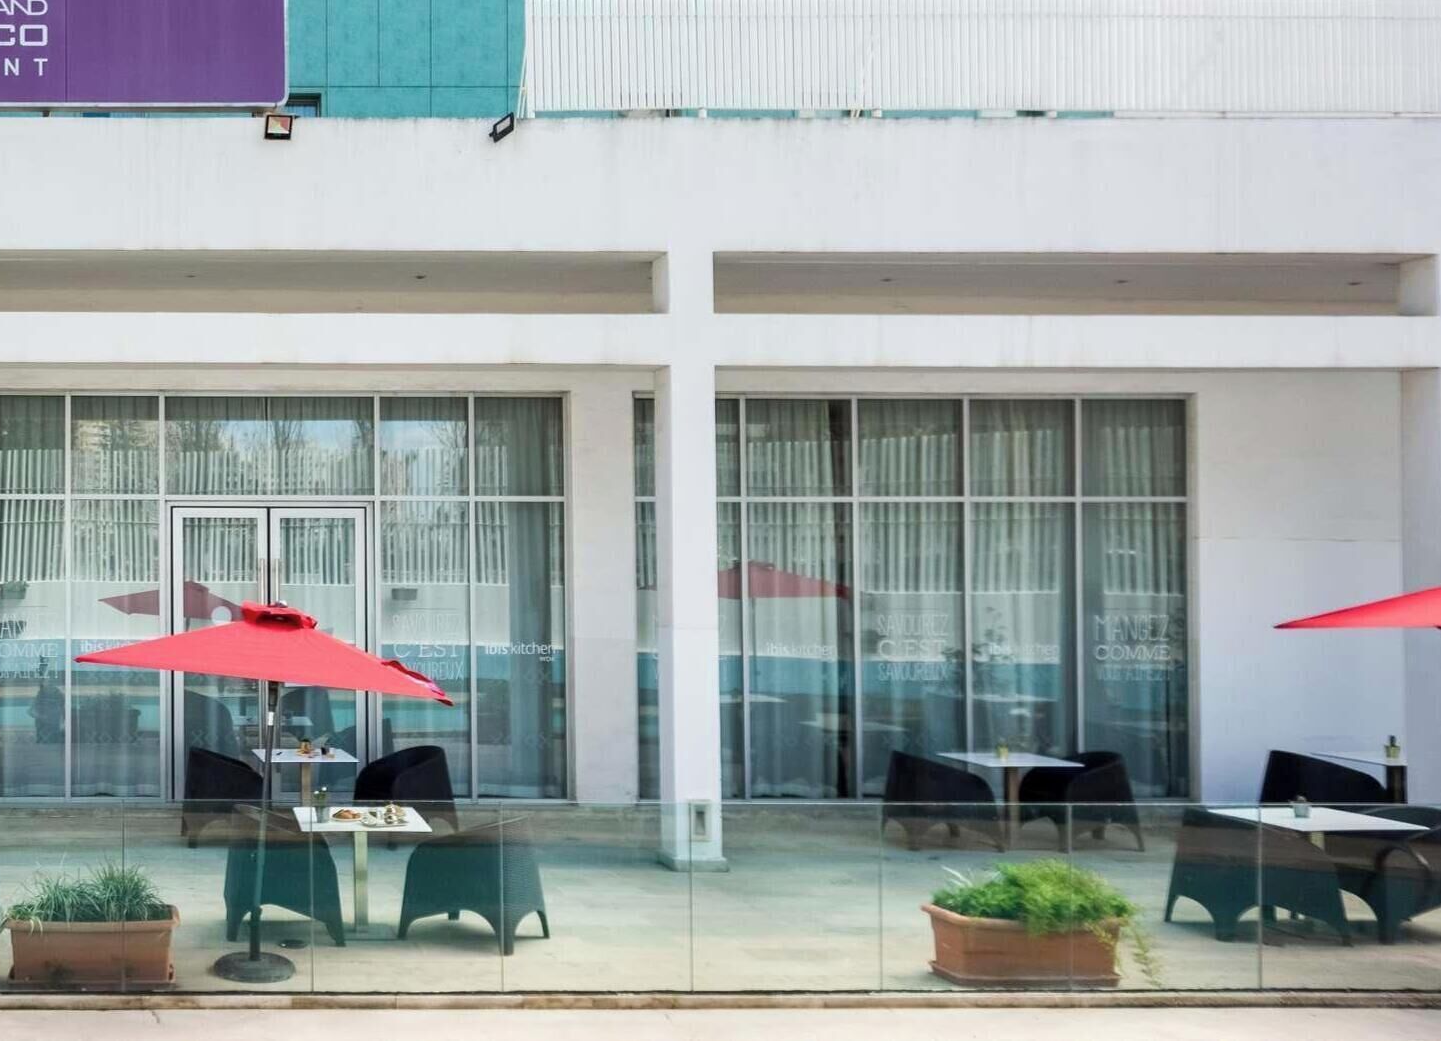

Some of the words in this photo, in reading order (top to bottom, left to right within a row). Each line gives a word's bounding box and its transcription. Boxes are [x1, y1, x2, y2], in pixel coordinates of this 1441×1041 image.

[1094, 614, 1169, 641] MANGEZ
[485, 642, 509, 655] ibis
[510, 642, 557, 655] kitchen
[1095, 645, 1170, 660] COMME
[401, 661, 464, 680] VOUREUX
